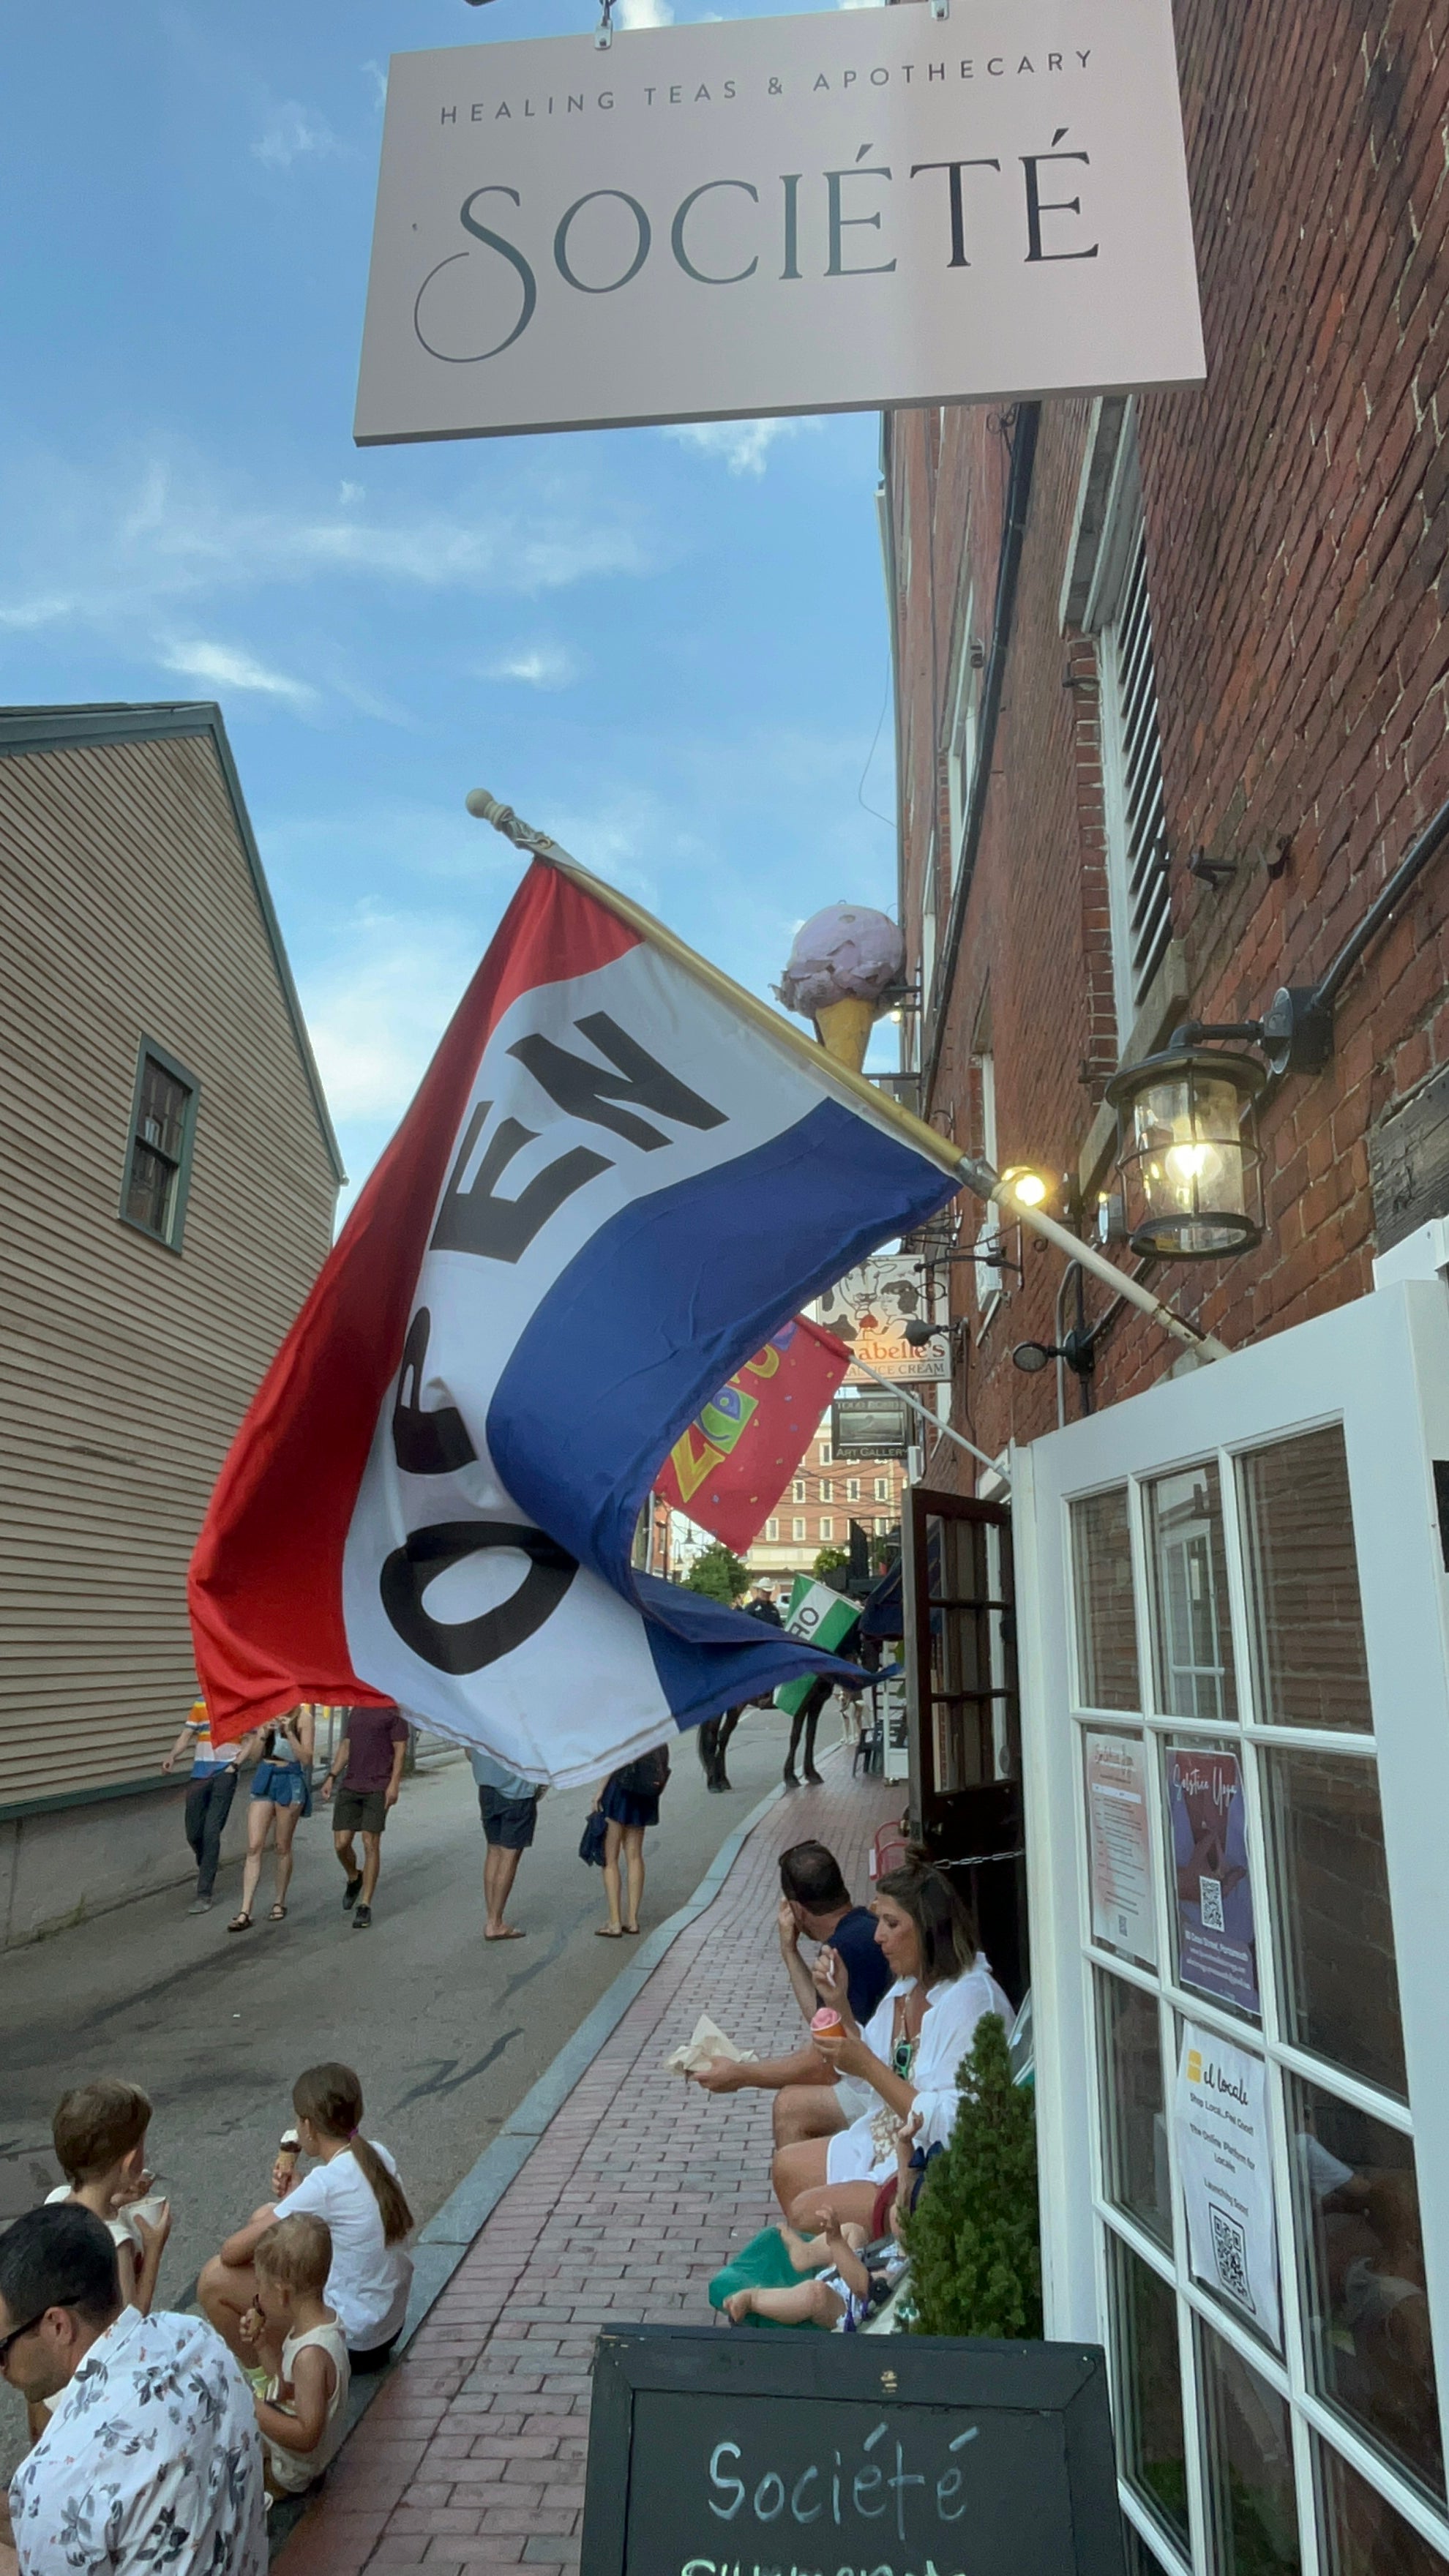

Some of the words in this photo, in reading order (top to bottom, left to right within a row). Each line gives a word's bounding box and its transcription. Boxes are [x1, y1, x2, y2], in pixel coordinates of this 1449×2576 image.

[441, 90, 617, 126] HEALING
[645, 79, 739, 107] TEAS
[768, 76, 784, 95] &
[812, 48, 1095, 93] APOTHECARY
[858, 1340, 946, 1360] abelle's
[898, 1363, 944, 1376] CREAM
[836, 1448, 856, 1457] ART
[707, 2421, 979, 2542] Société
